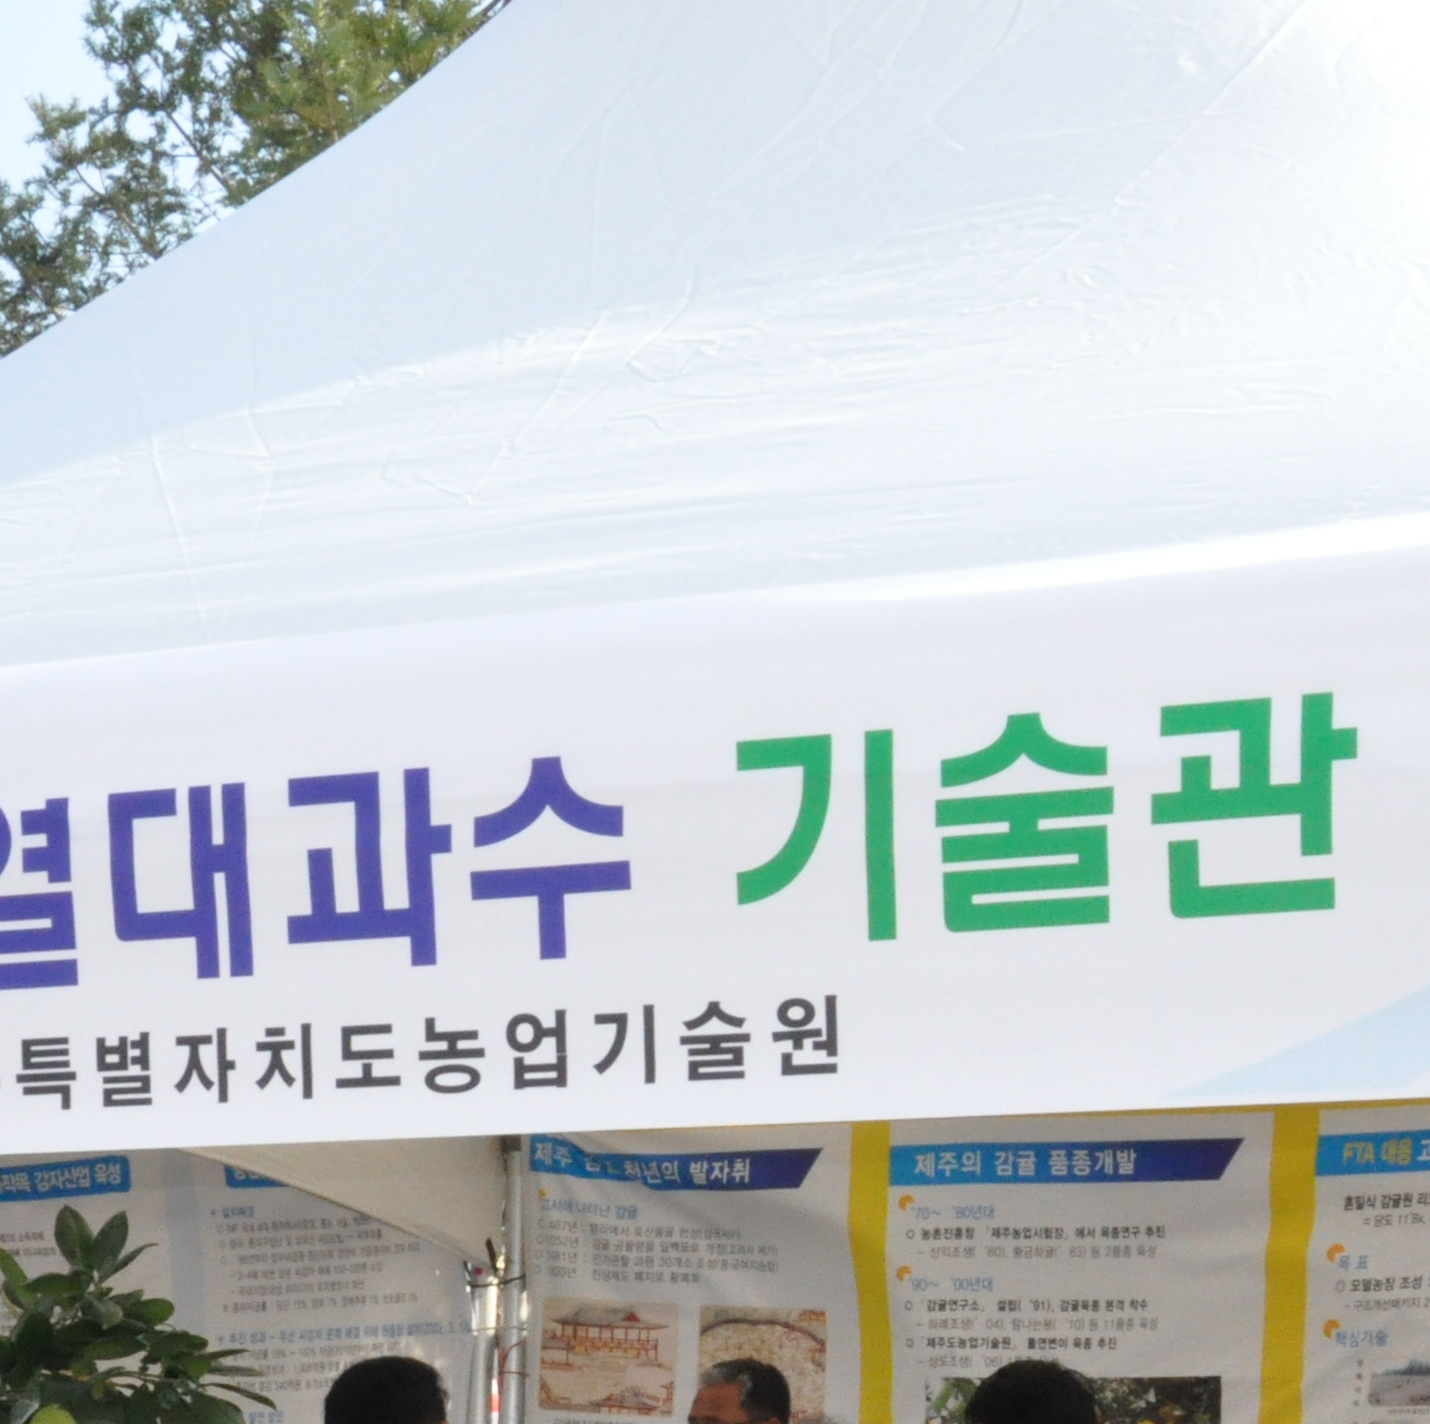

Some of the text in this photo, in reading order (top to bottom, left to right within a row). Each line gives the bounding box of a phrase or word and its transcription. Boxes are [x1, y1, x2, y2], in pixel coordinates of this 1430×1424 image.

[733, 690, 1360, 944] 기술관
[914, 1150, 1137, 1178] 제주의 감귤 품종개발
[1342, 1141, 1375, 1166] FTA
[689, 1158, 752, 1185] 발자취
